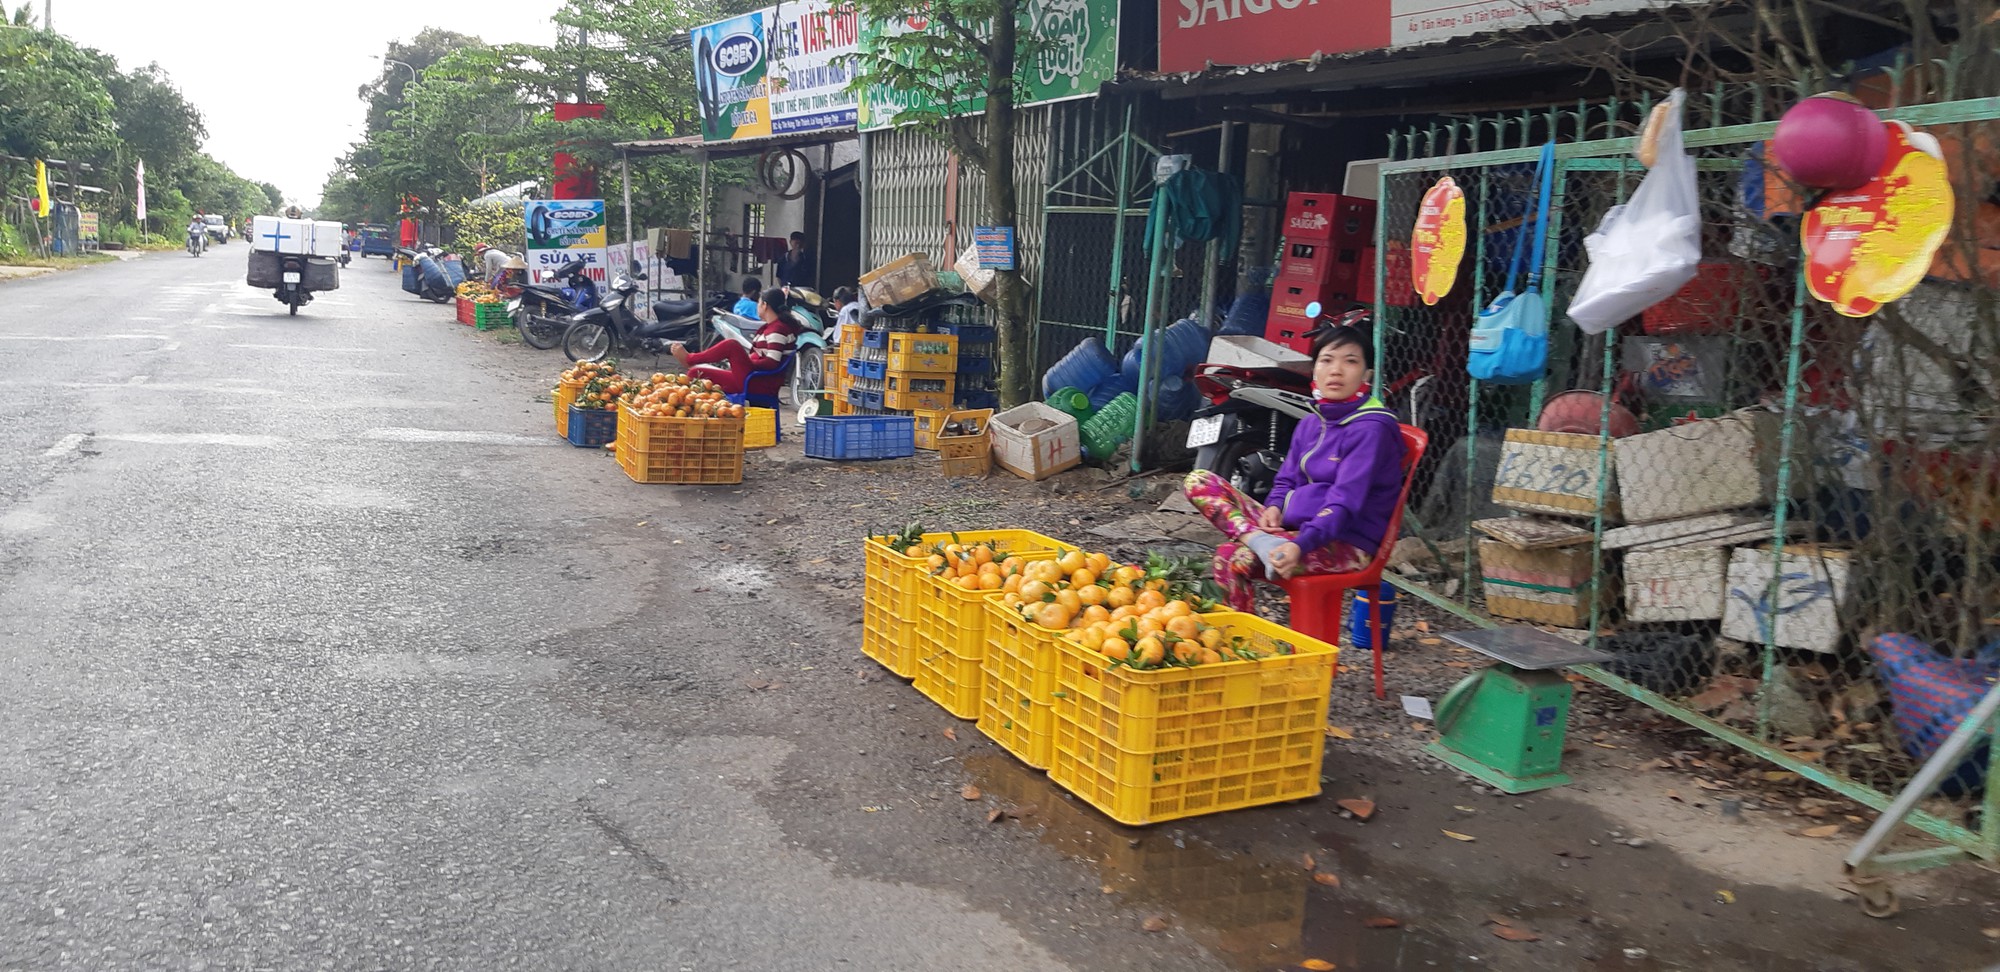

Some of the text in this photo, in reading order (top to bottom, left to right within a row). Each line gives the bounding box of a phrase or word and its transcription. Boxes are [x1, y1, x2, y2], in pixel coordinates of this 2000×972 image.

[801, 3, 826, 54] VĂN
[828, 4, 858, 49] THU
[1421, 19, 1435, 29] Tân
[719, 40, 753, 68] SOBEK
[798, 97, 811, 113] PHỤ
[812, 93, 829, 110] TÙNG
[554, 211, 589, 219] SOBEK
[540, 249, 597, 264] SỬA XE
